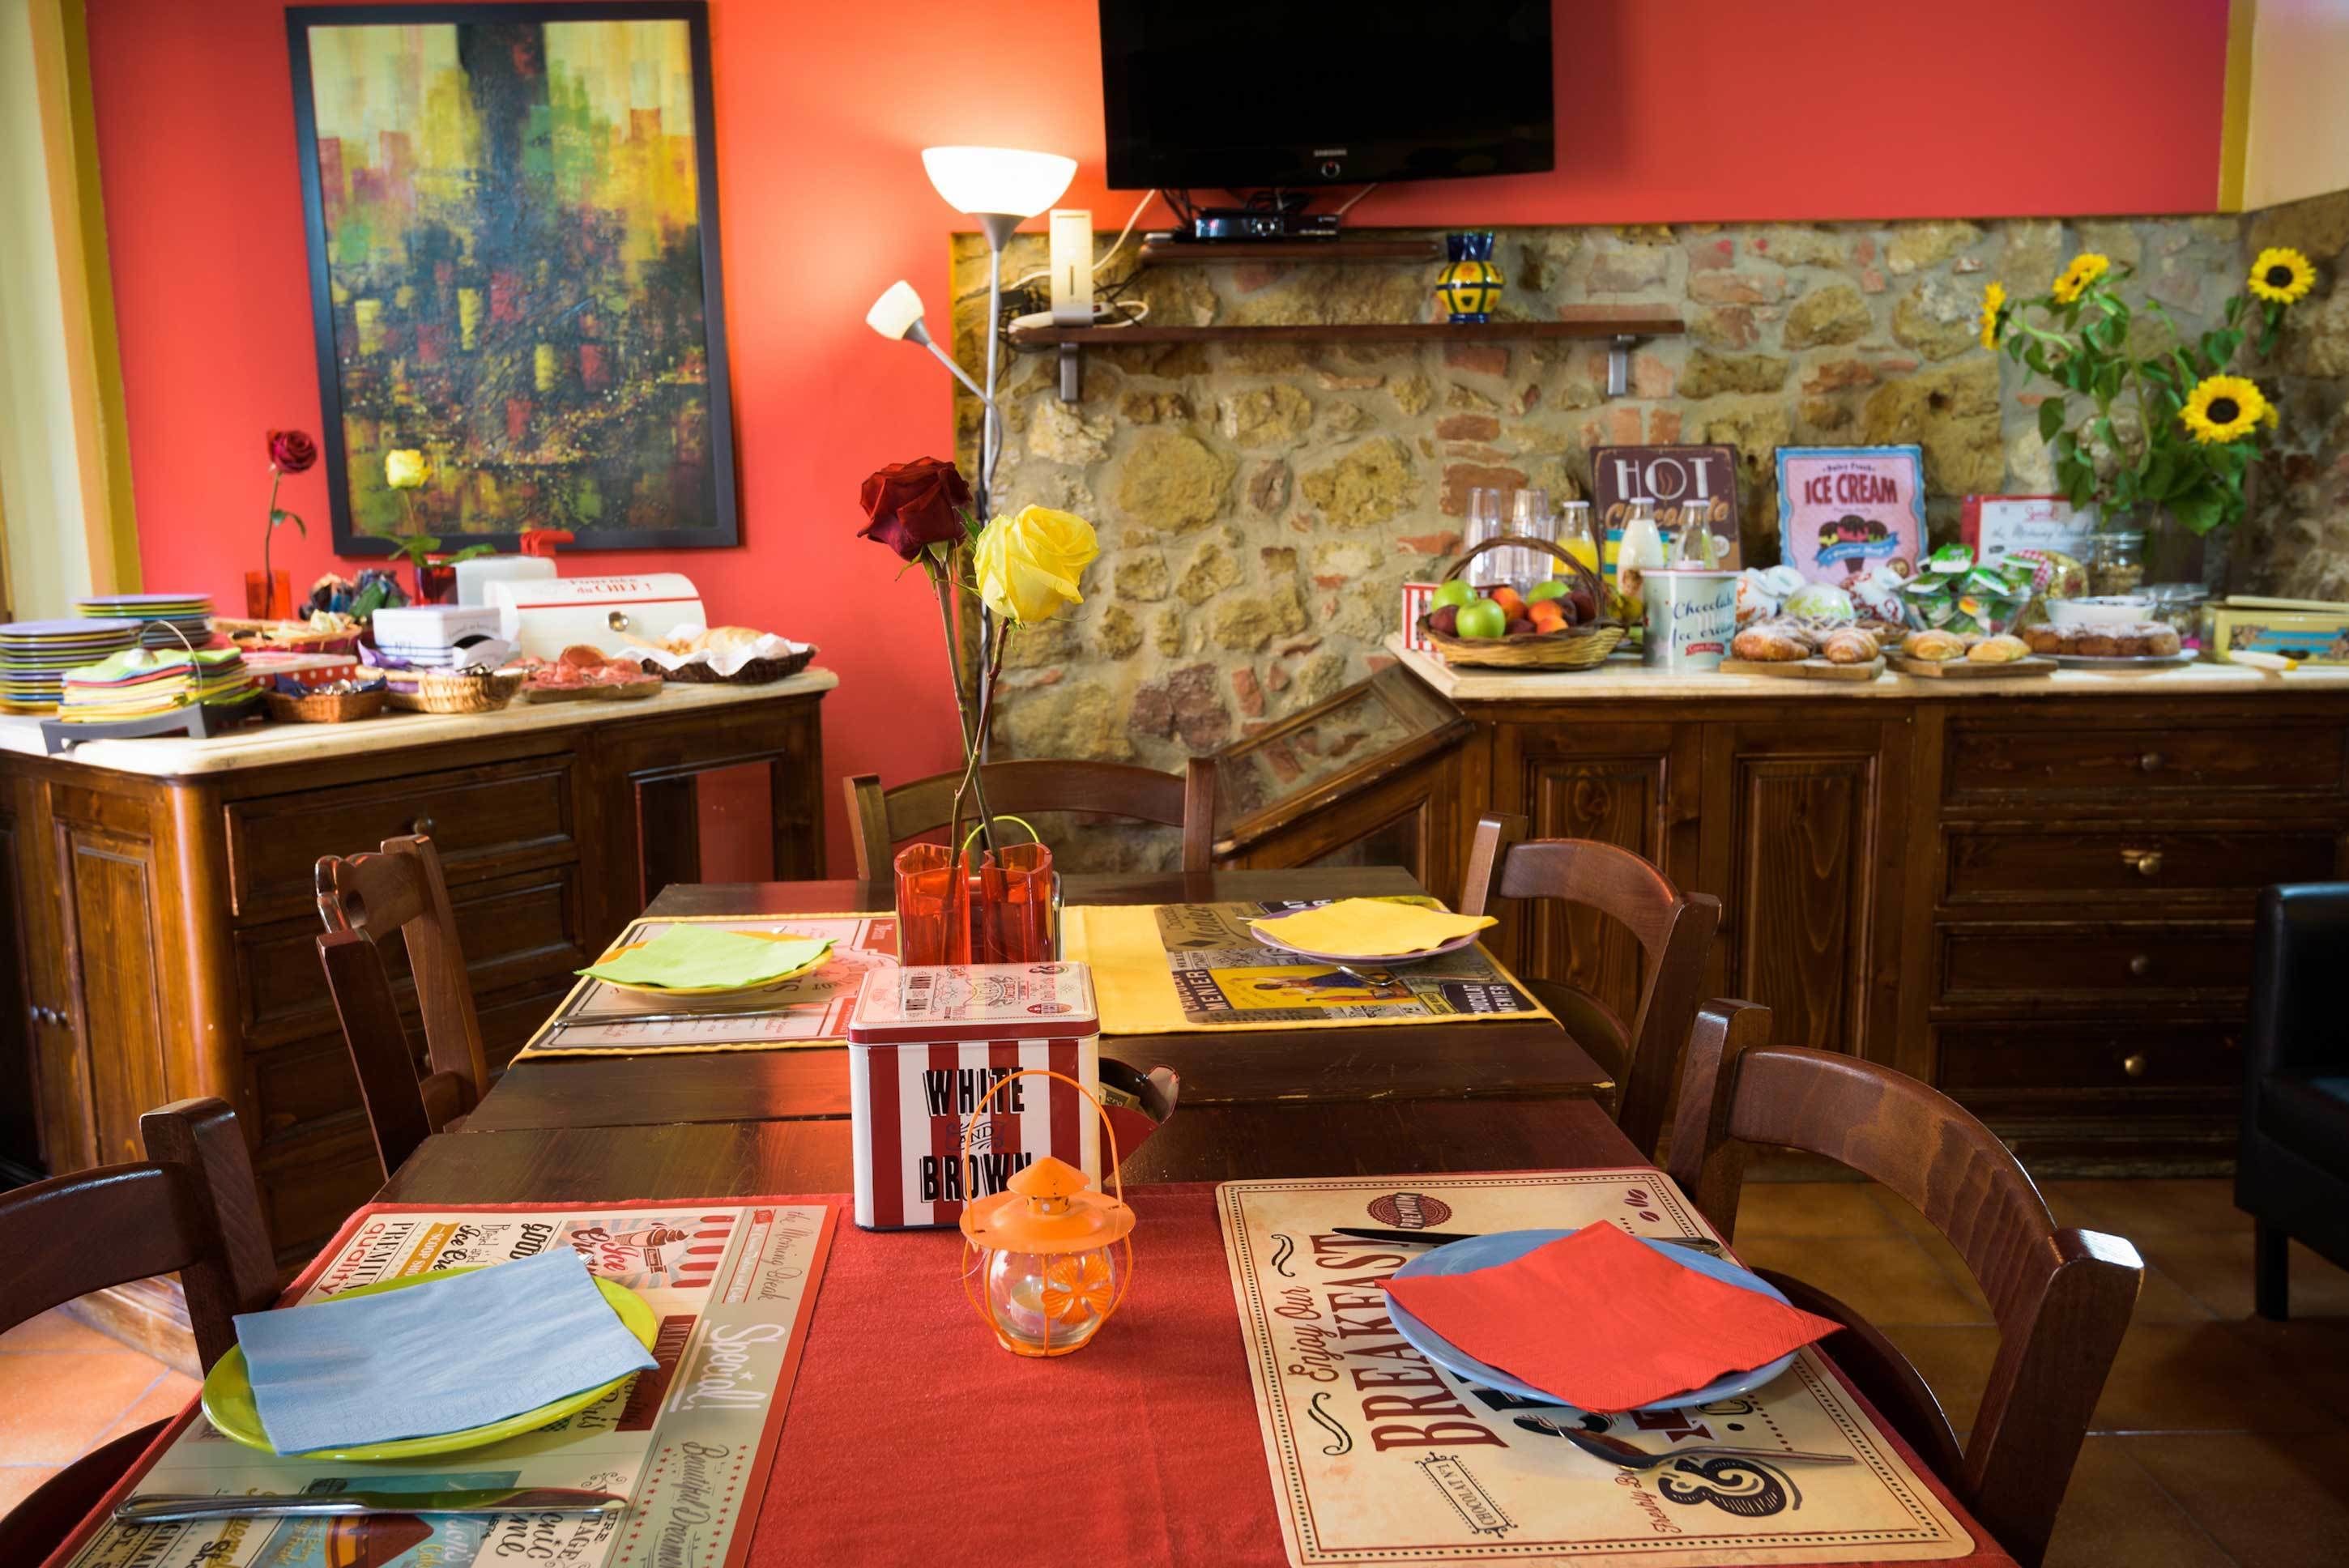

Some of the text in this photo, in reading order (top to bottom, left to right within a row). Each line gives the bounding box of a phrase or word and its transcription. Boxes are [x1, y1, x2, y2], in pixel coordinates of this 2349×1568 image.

[1614, 457, 1713, 500] HOT
[1805, 473, 1898, 505] ICE CREAM
[1187, 970, 1230, 1011] MENIER
[922, 1067, 1025, 1117] WHITE
[779, 1211, 811, 1225] the
[1396, 1193, 1425, 1229] PREMIUM
[318, 1223, 386, 1294] quality
[419, 1232, 445, 1259] SCOOP
[600, 1243, 639, 1271] Ice
[761, 1228, 814, 1266] Morning
[758, 1267, 803, 1300] Break
[1274, 1286, 1345, 1382] Enjoy Our
[1310, 1234, 1510, 1451] BREAKFAST
[681, 1323, 786, 1410] Special!
[671, 1442, 729, 1509] Beautiful
[1448, 1480, 1497, 1525] CHOCOLAT
